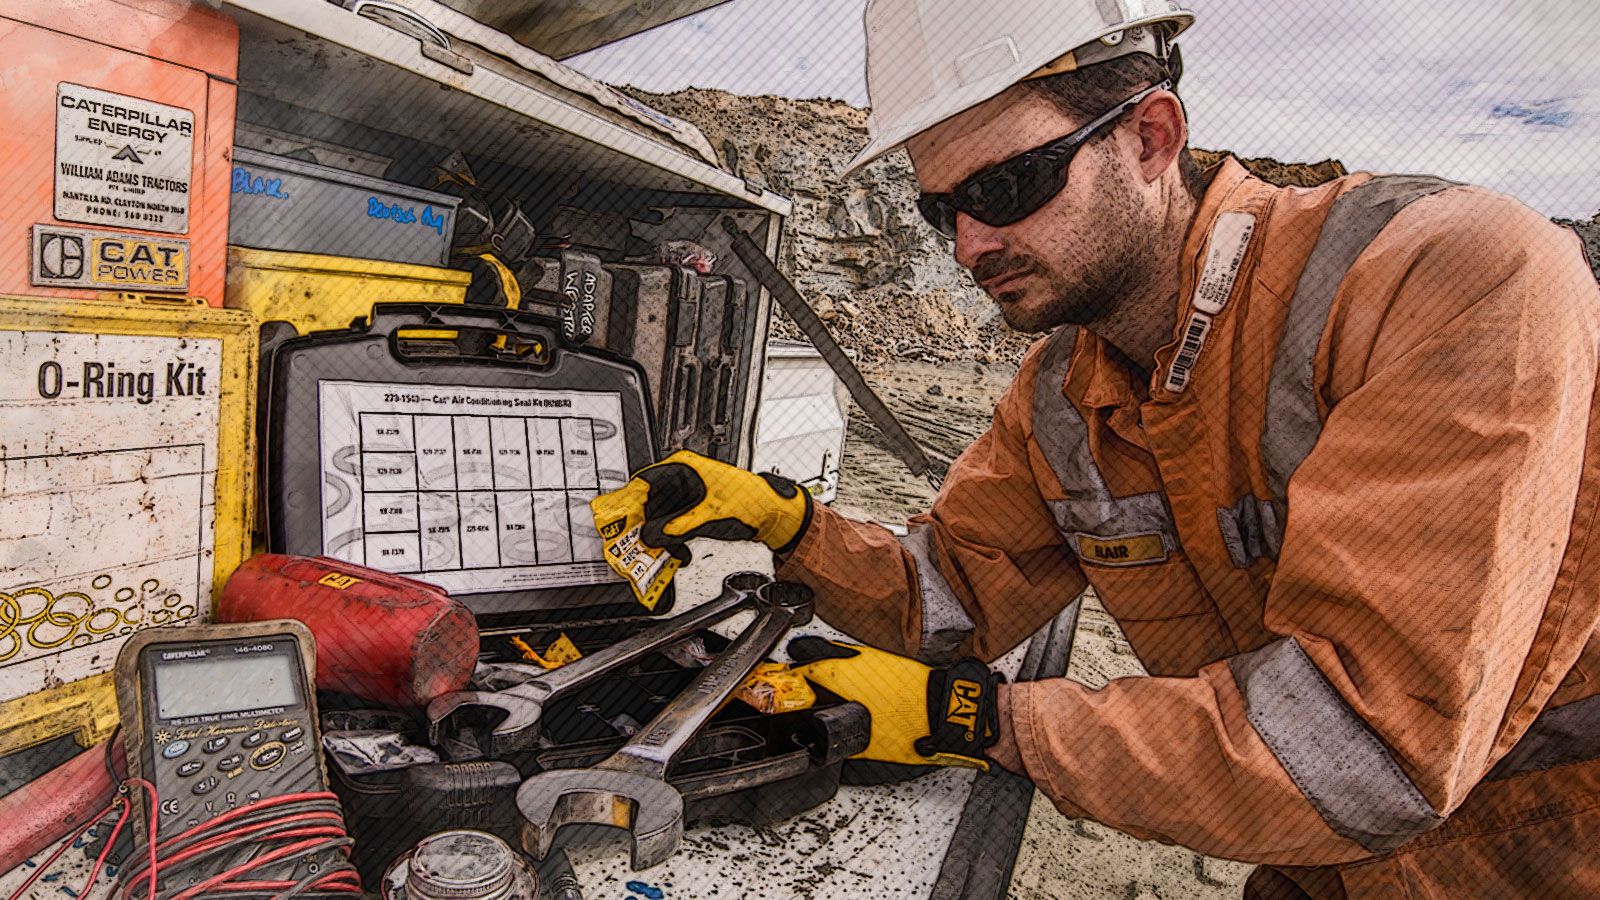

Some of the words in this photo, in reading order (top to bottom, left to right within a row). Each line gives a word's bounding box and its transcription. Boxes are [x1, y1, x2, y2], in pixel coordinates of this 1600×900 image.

[60, 95, 192, 133] CATERPILLAR
[87, 117, 167, 143] ENERGY
[60, 162, 103, 181] WILLIAM
[105, 170, 139, 187] ADAMS
[141, 175, 188, 194] TRACTORS
[100, 241, 179, 267] CAT
[98, 264, 179, 282] POWER
[38, 360, 155, 404] O-Ring
[165, 362, 206, 397] Kit
[319, 572, 362, 590] CAT
[947, 680, 982, 730] CAT
